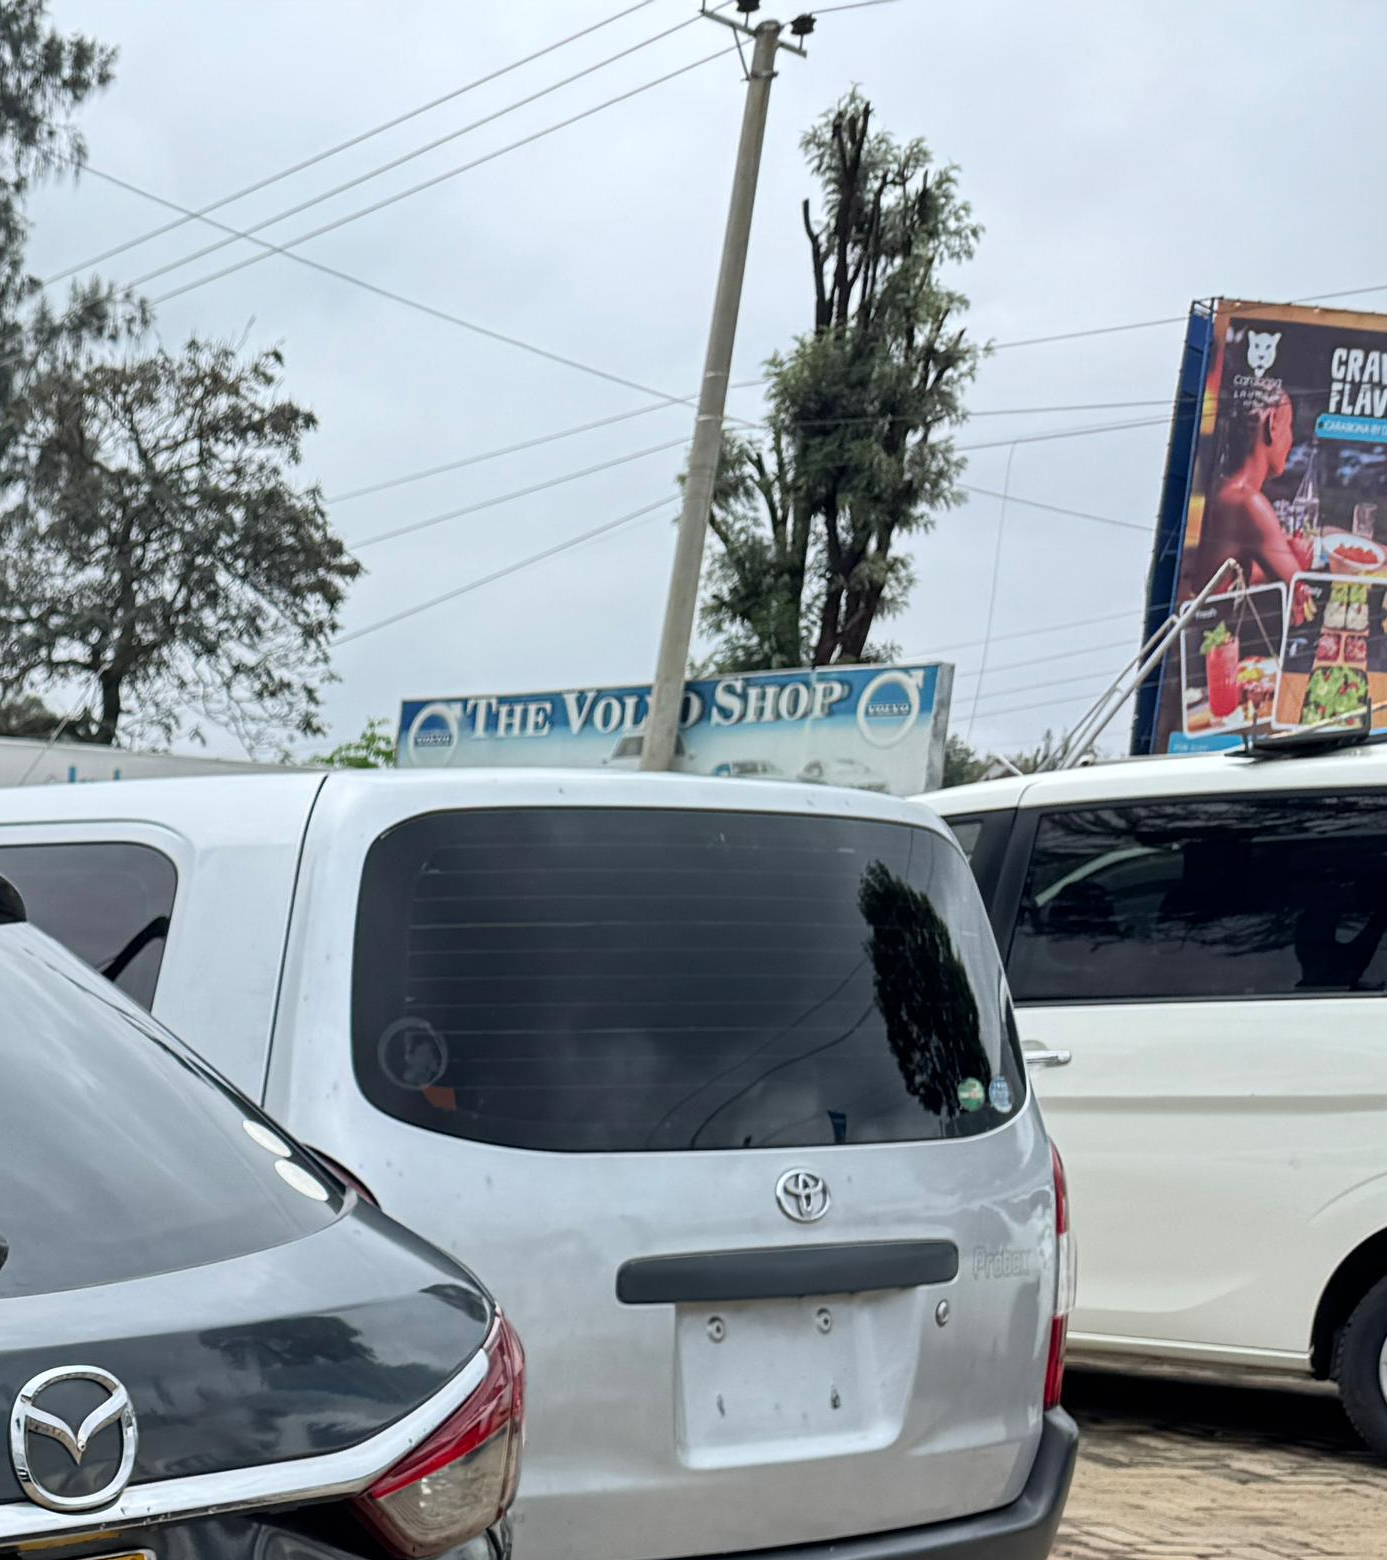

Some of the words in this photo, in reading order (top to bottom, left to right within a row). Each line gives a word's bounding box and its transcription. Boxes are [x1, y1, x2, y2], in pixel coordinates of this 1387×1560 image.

[467, 697, 554, 738] THE
[562, 690, 702, 735] VOLO
[711, 677, 845, 726] SHOP
